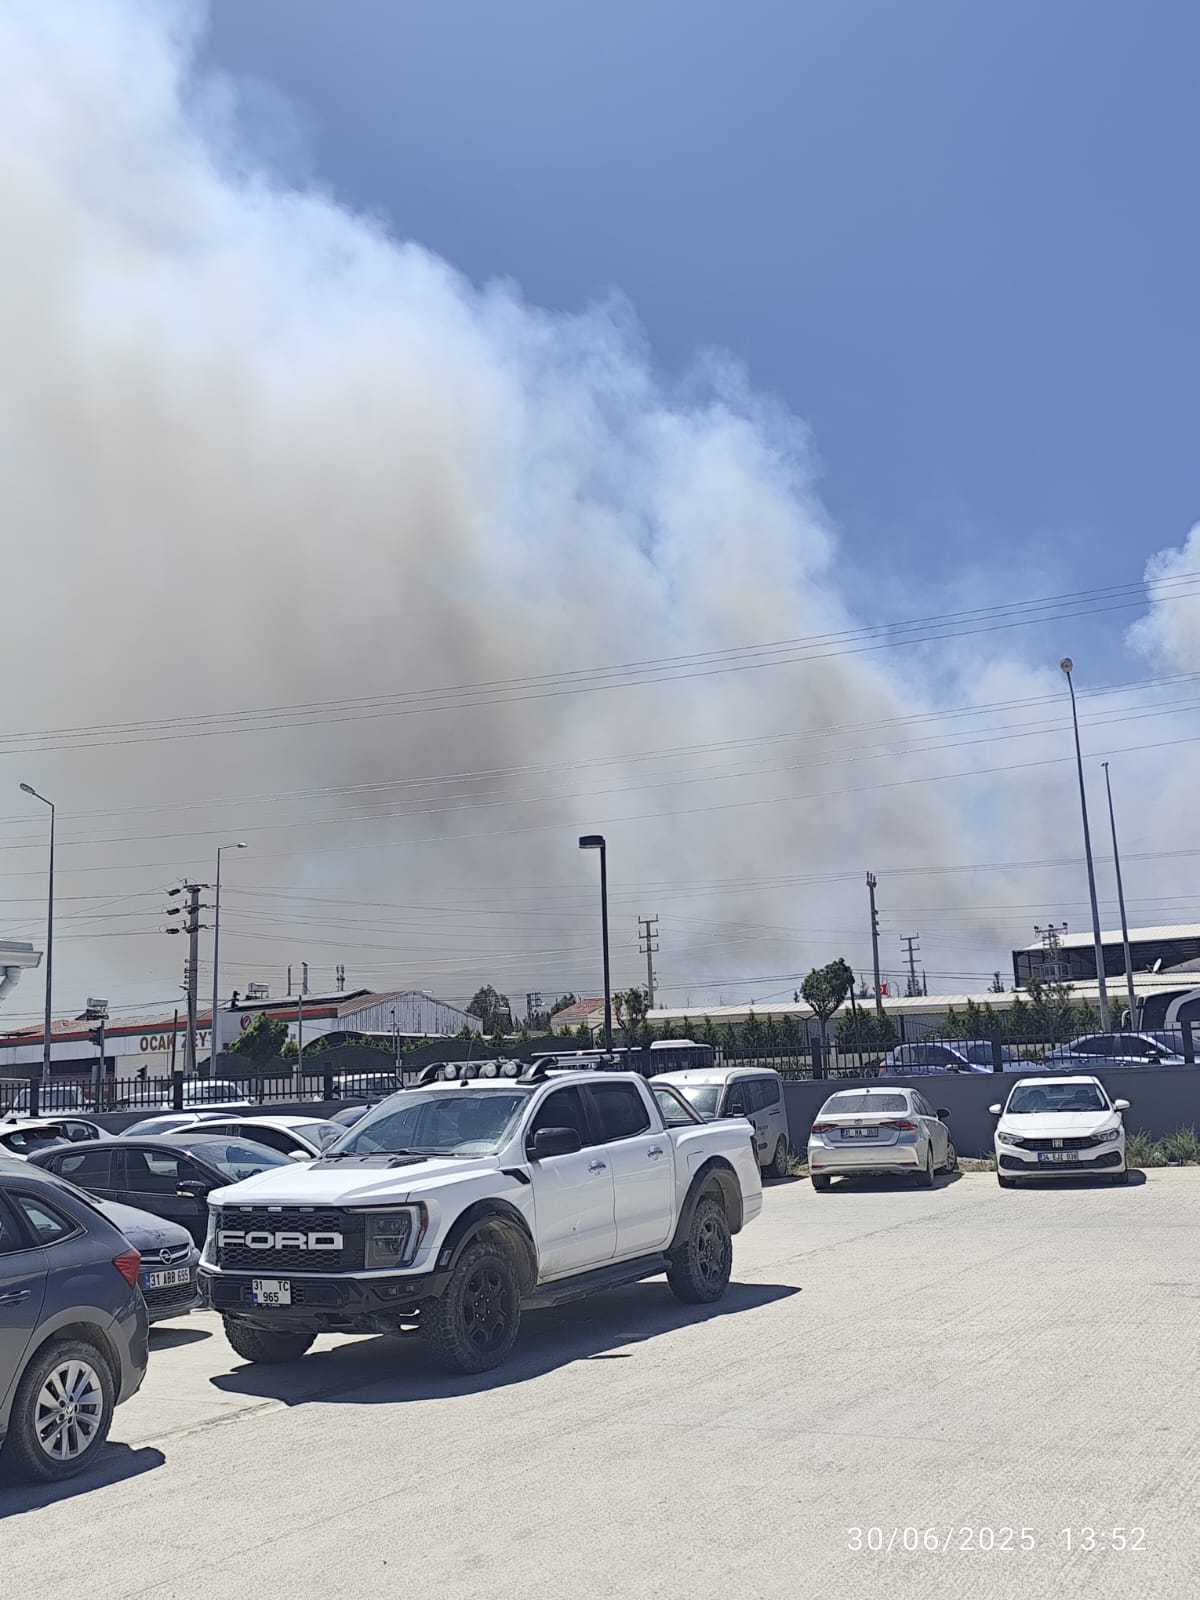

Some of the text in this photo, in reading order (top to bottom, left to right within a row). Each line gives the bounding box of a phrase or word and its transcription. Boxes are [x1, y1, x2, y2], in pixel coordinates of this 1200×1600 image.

[218, 1230, 343, 1250] FORD
[151, 1273, 160, 1287] 31
[253, 1281, 289, 1292] 31 TC
[263, 1292, 279, 1303] 965
